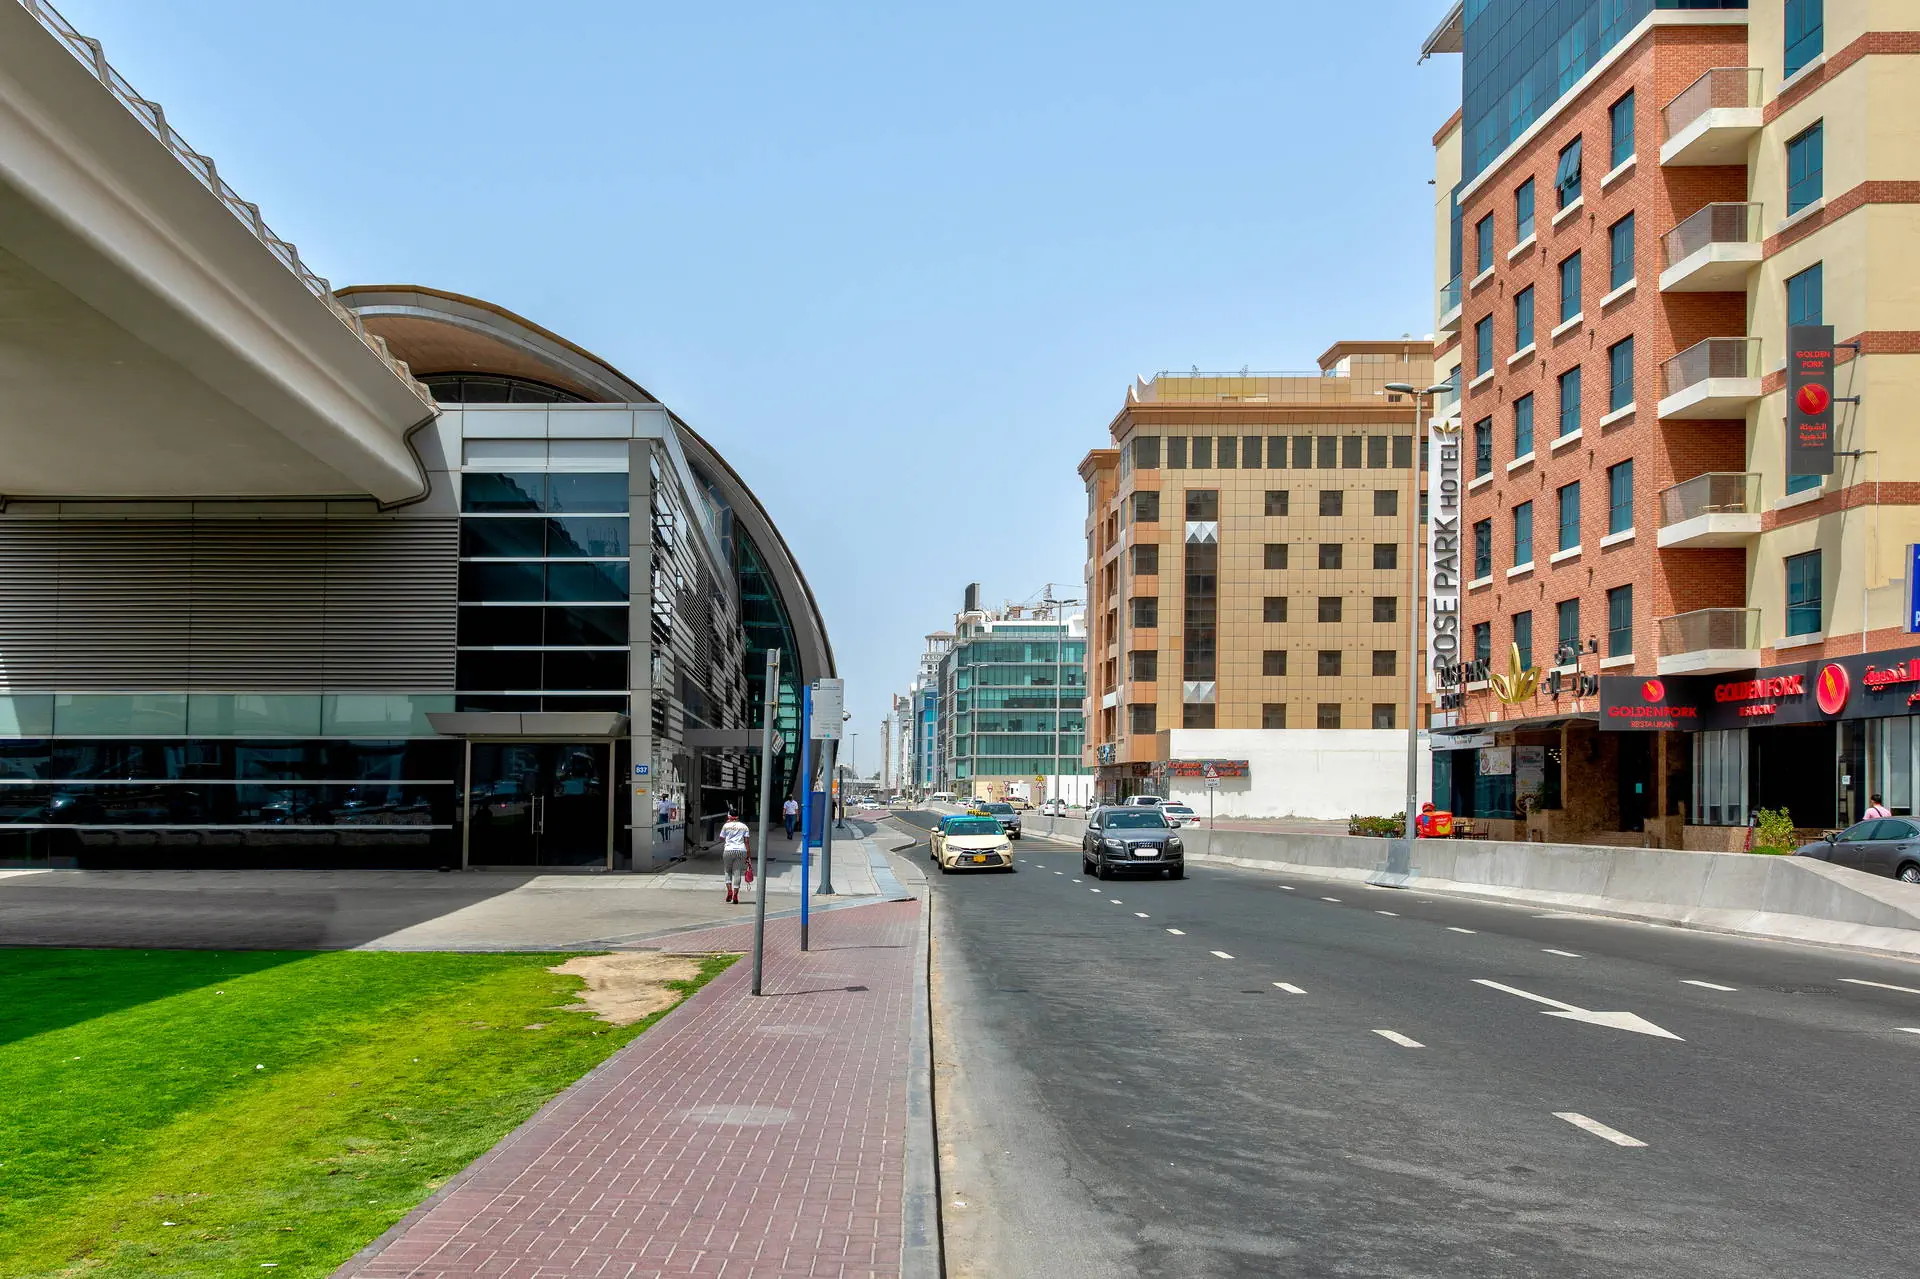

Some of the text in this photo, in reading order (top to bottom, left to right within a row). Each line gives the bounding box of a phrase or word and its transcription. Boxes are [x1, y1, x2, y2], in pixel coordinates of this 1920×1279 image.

[1796, 350, 1831, 359] GOLDEN
[1801, 361, 1824, 369] FORK
[1433, 437, 1459, 671] ROSE PARK HOTEL
[1714, 674, 1805, 703] GOLDEN FORK
[1630, 720, 1678, 729] RESTAURANT
